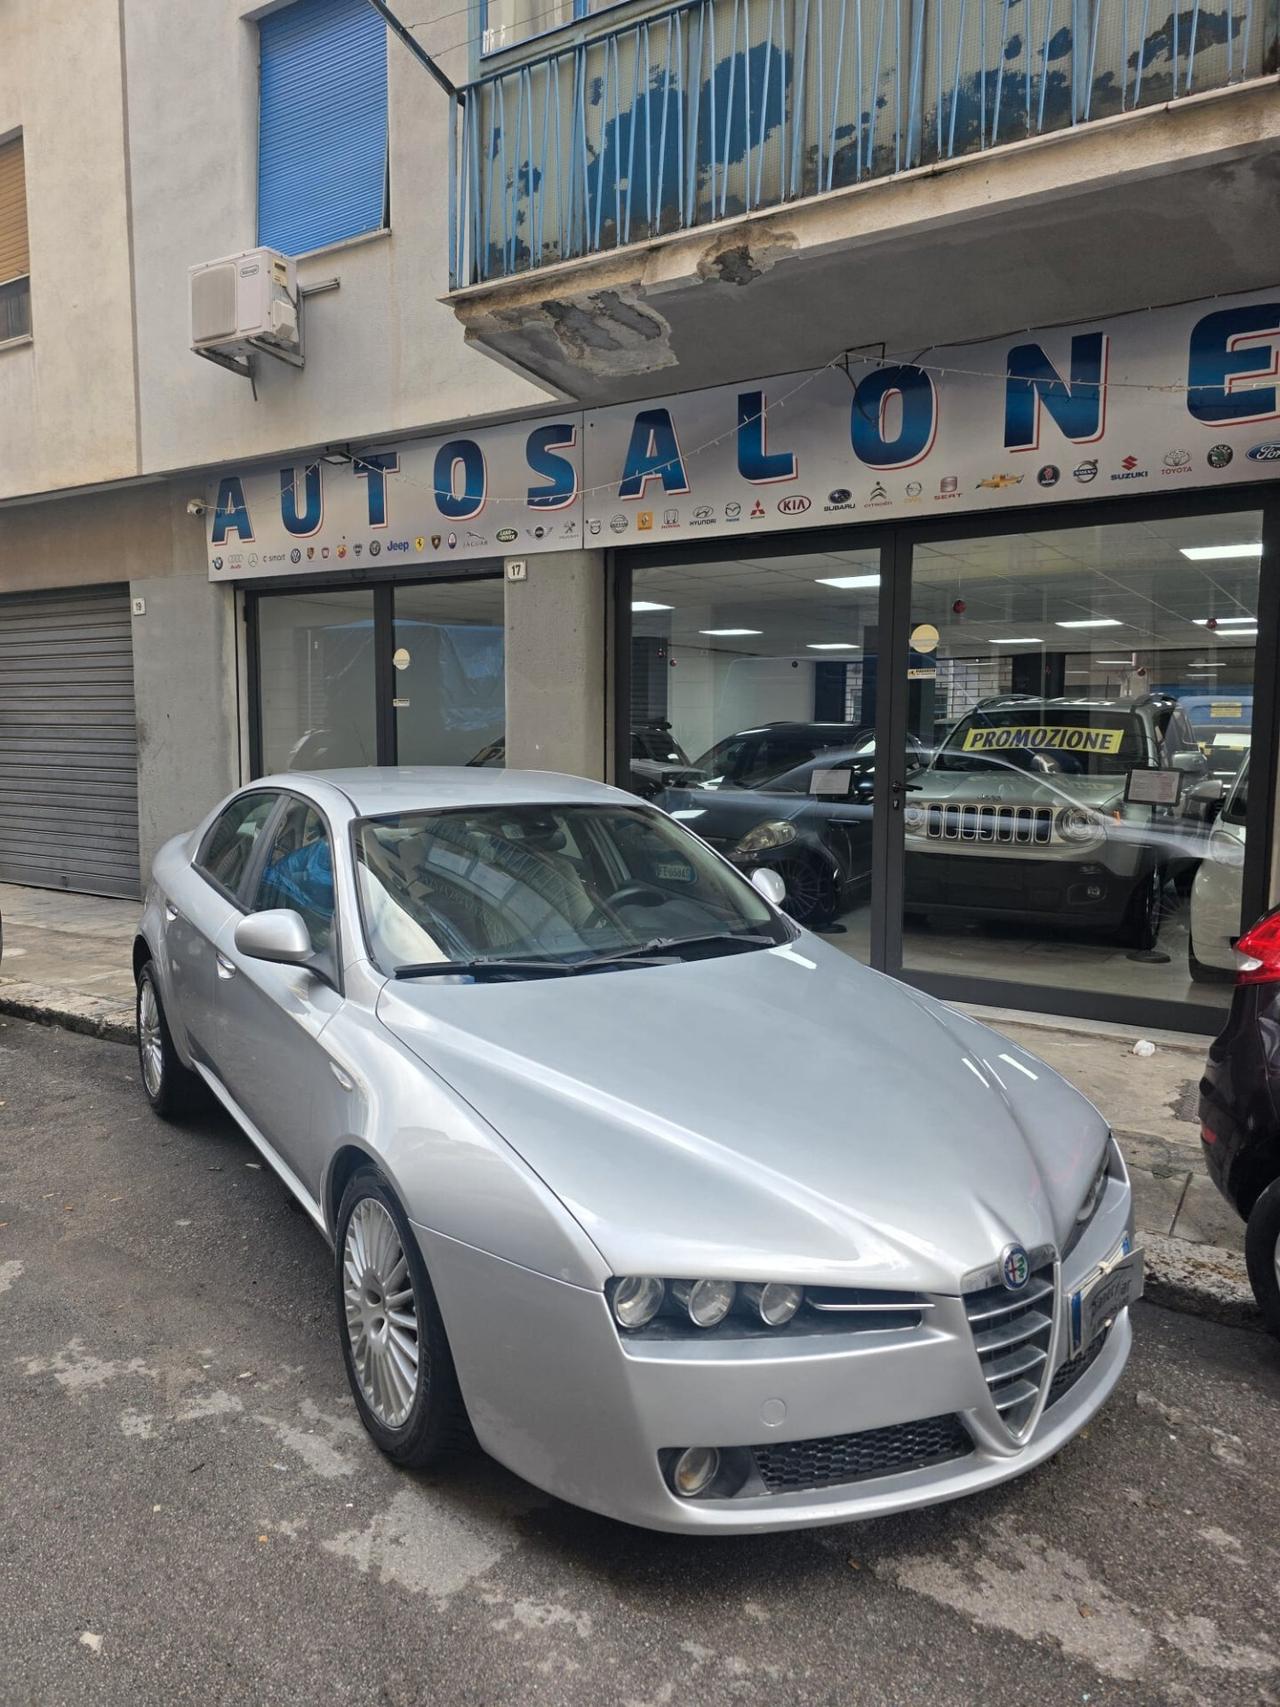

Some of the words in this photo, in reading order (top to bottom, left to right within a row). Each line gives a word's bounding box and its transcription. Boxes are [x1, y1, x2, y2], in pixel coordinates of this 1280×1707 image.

[1110, 471, 1148, 480] SUZUKI
[1161, 466, 1192, 475] TOYOTA
[783, 499, 805, 511] KIA
[824, 503, 856, 512] SUBARU
[689, 518, 717, 526] HYUNDAI
[387, 540, 409, 552] Jeep
[512, 564, 521, 576] 17
[969, 727, 1113, 750] PROMOZIONE
